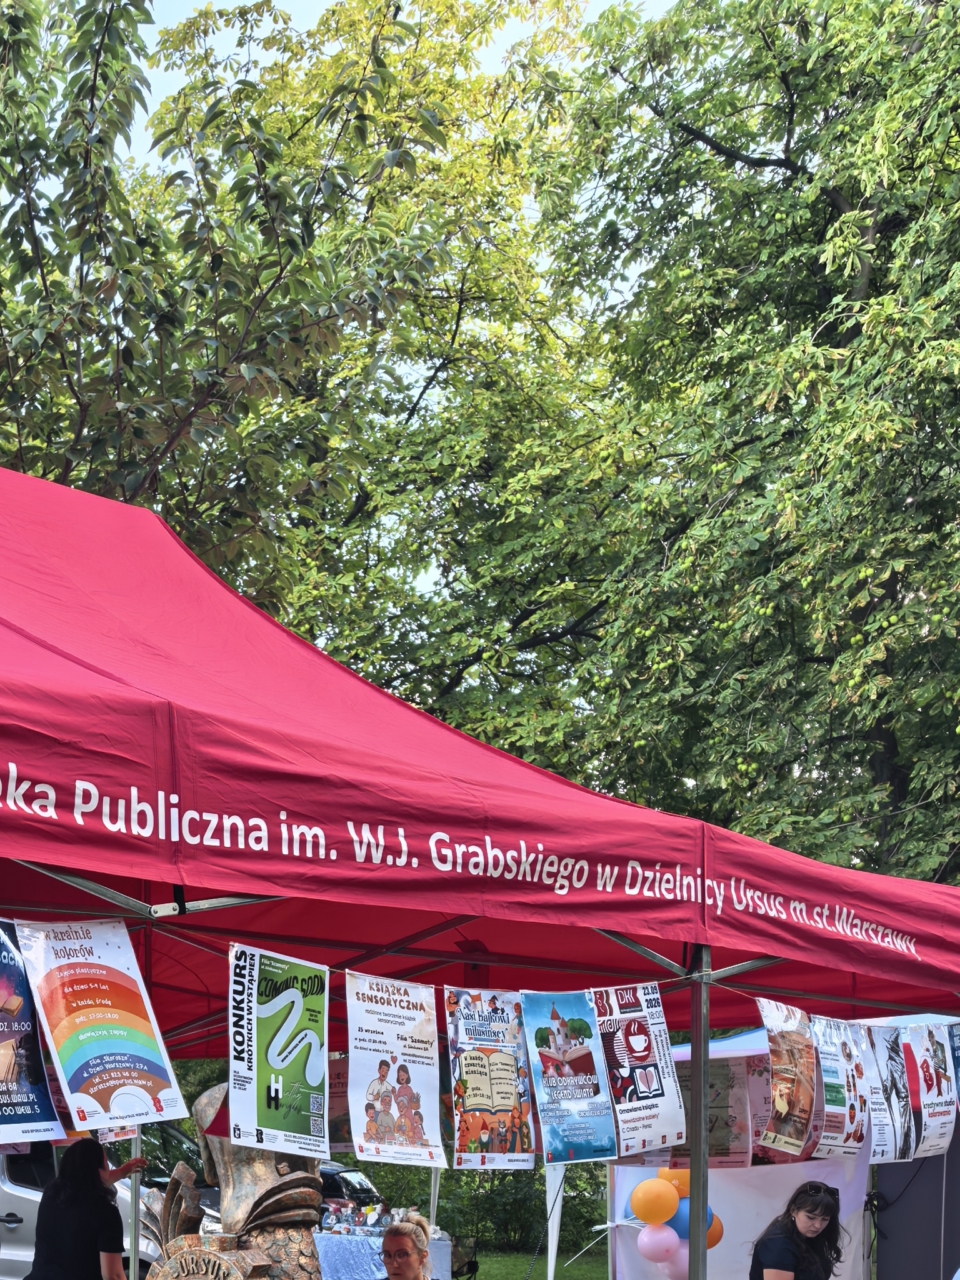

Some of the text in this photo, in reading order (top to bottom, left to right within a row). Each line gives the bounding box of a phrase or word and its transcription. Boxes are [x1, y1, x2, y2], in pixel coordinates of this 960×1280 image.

[72, 778, 269, 852] Publiczna
[279, 810, 337, 860] im.
[347, 820, 419, 868] W.J.
[429, 831, 589, 895] Grabskiego
[597, 863, 619, 892] w
[625, 859, 725, 915] Dzielnicy
[731, 876, 786, 920] Ursus
[52, 925, 92, 941] krainie
[52, 944, 94, 959] kolorów
[246, 953, 256, 1016] WYSTĄPIEŃ
[301, 974, 325, 998] SOON
[368, 982, 410, 998] KSIĄŻKA
[642, 986, 658, 996] 23.09
[233, 950, 248, 1063] KONKURS
[355, 991, 426, 1013] SENSORYCZNA
[645, 998, 661, 1009] 2026
[478, 1009, 510, 1026] bajkowi
[12, 1022, 31, 1031] 18:00
[465, 1025, 508, 1043] milusińscy
[558, 1073, 598, 1086] ODKRYWCÓW
[552, 1087, 594, 1100] LEGEND ŚWIATA
[944, 1098, 955, 1107] studio
